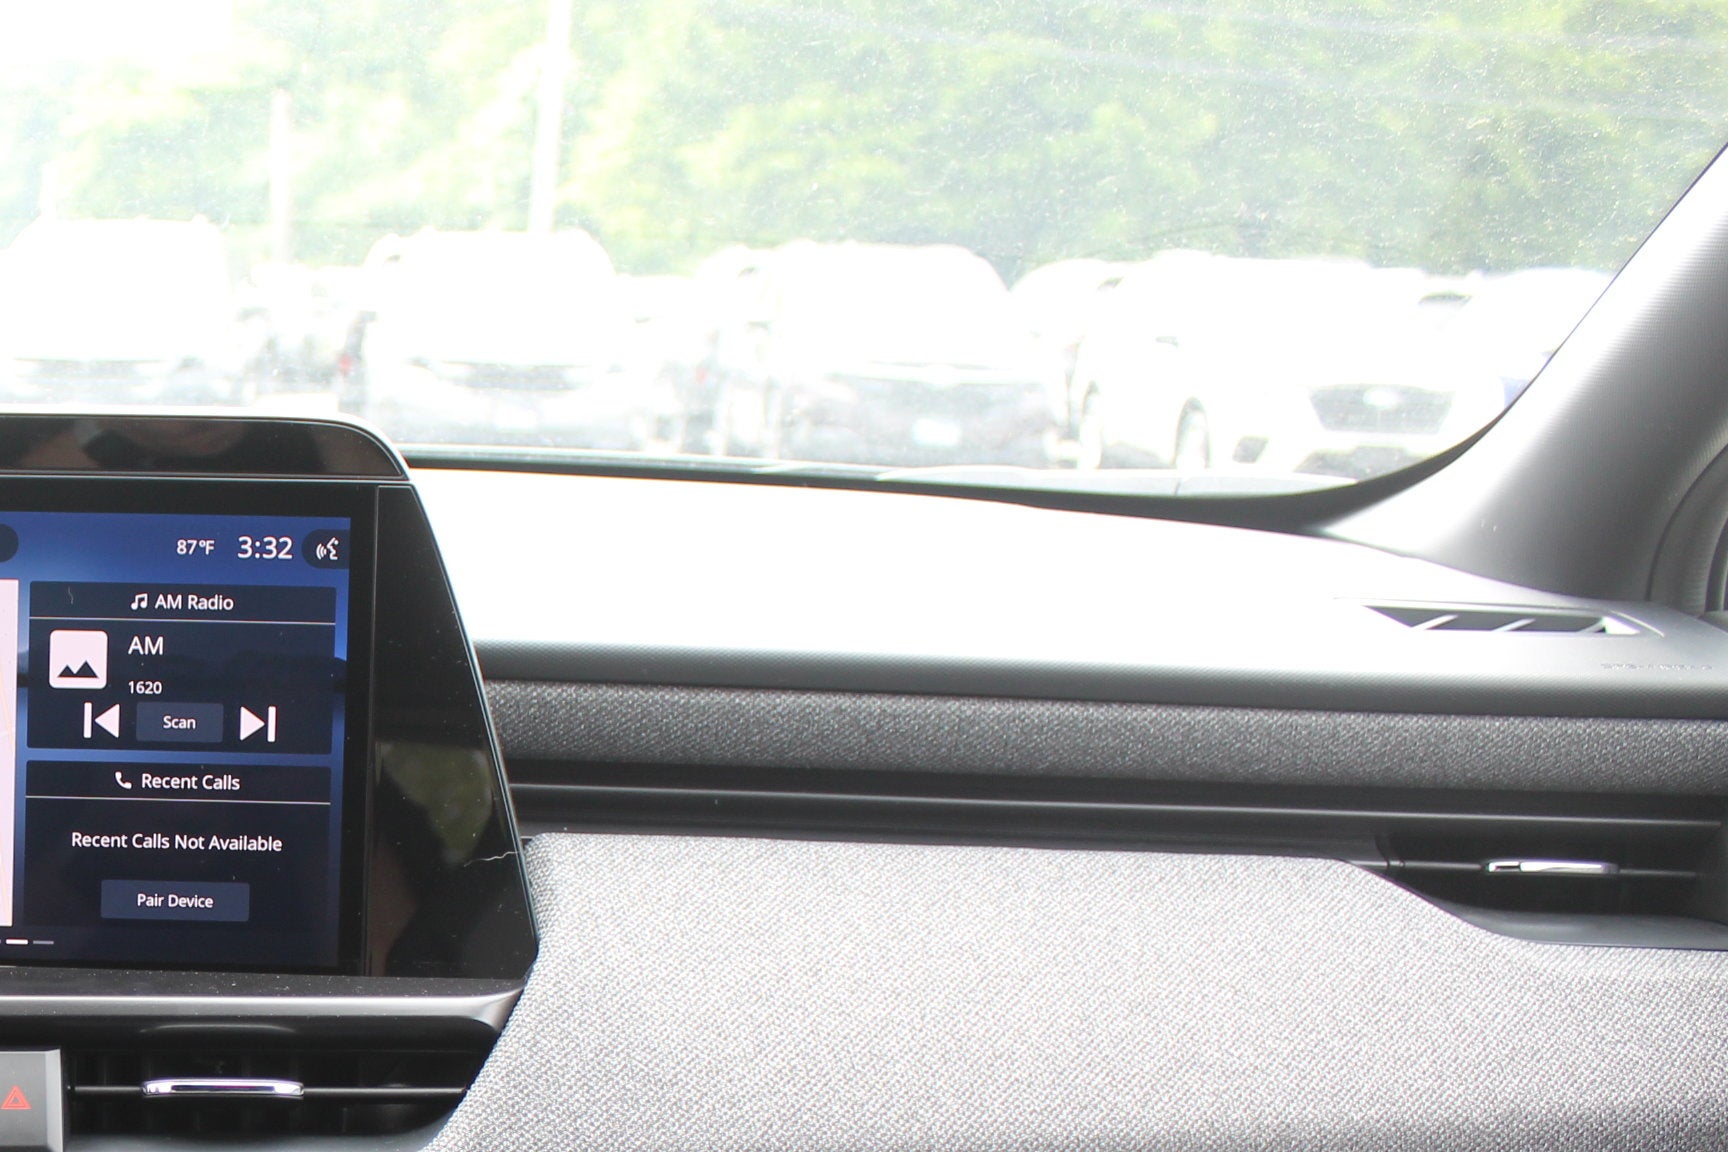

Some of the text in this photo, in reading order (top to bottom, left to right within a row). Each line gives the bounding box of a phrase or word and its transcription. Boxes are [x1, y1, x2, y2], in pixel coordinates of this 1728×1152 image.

[176, 539, 215, 556] 87°F
[237, 536, 294, 560] 3:32
[154, 594, 234, 611] AM Radio
[128, 636, 164, 656] AM
[128, 681, 163, 695] 1620
[162, 715, 196, 730] Scan
[141, 772, 240, 791] Recent Calls
[72, 832, 283, 852] Recent Calls Not Available
[136, 892, 214, 908] Pair Device
